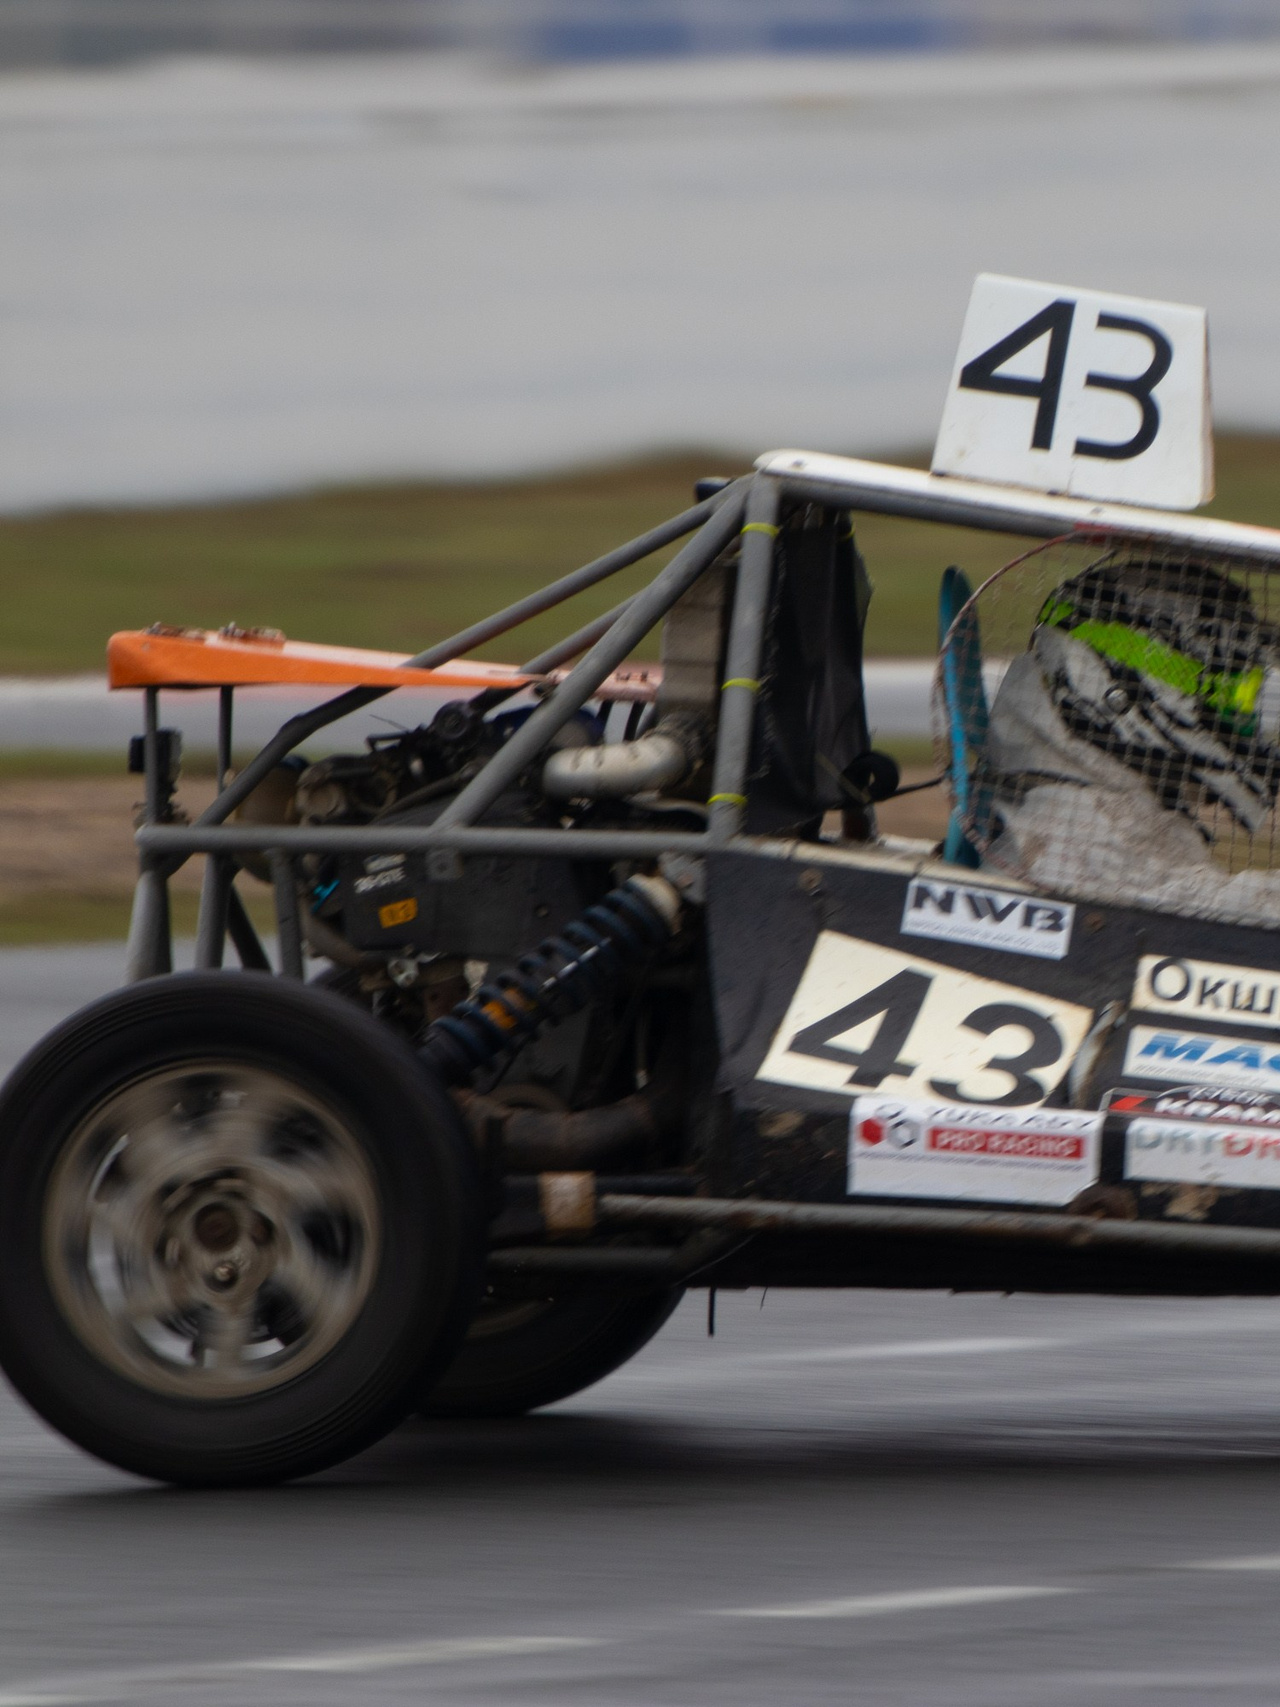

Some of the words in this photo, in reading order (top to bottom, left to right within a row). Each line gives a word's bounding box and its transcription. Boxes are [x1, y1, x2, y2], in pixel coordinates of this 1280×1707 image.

[958, 297, 1174, 461] 43
[912, 883, 1066, 932] NWB
[784, 965, 1064, 1107] 43
